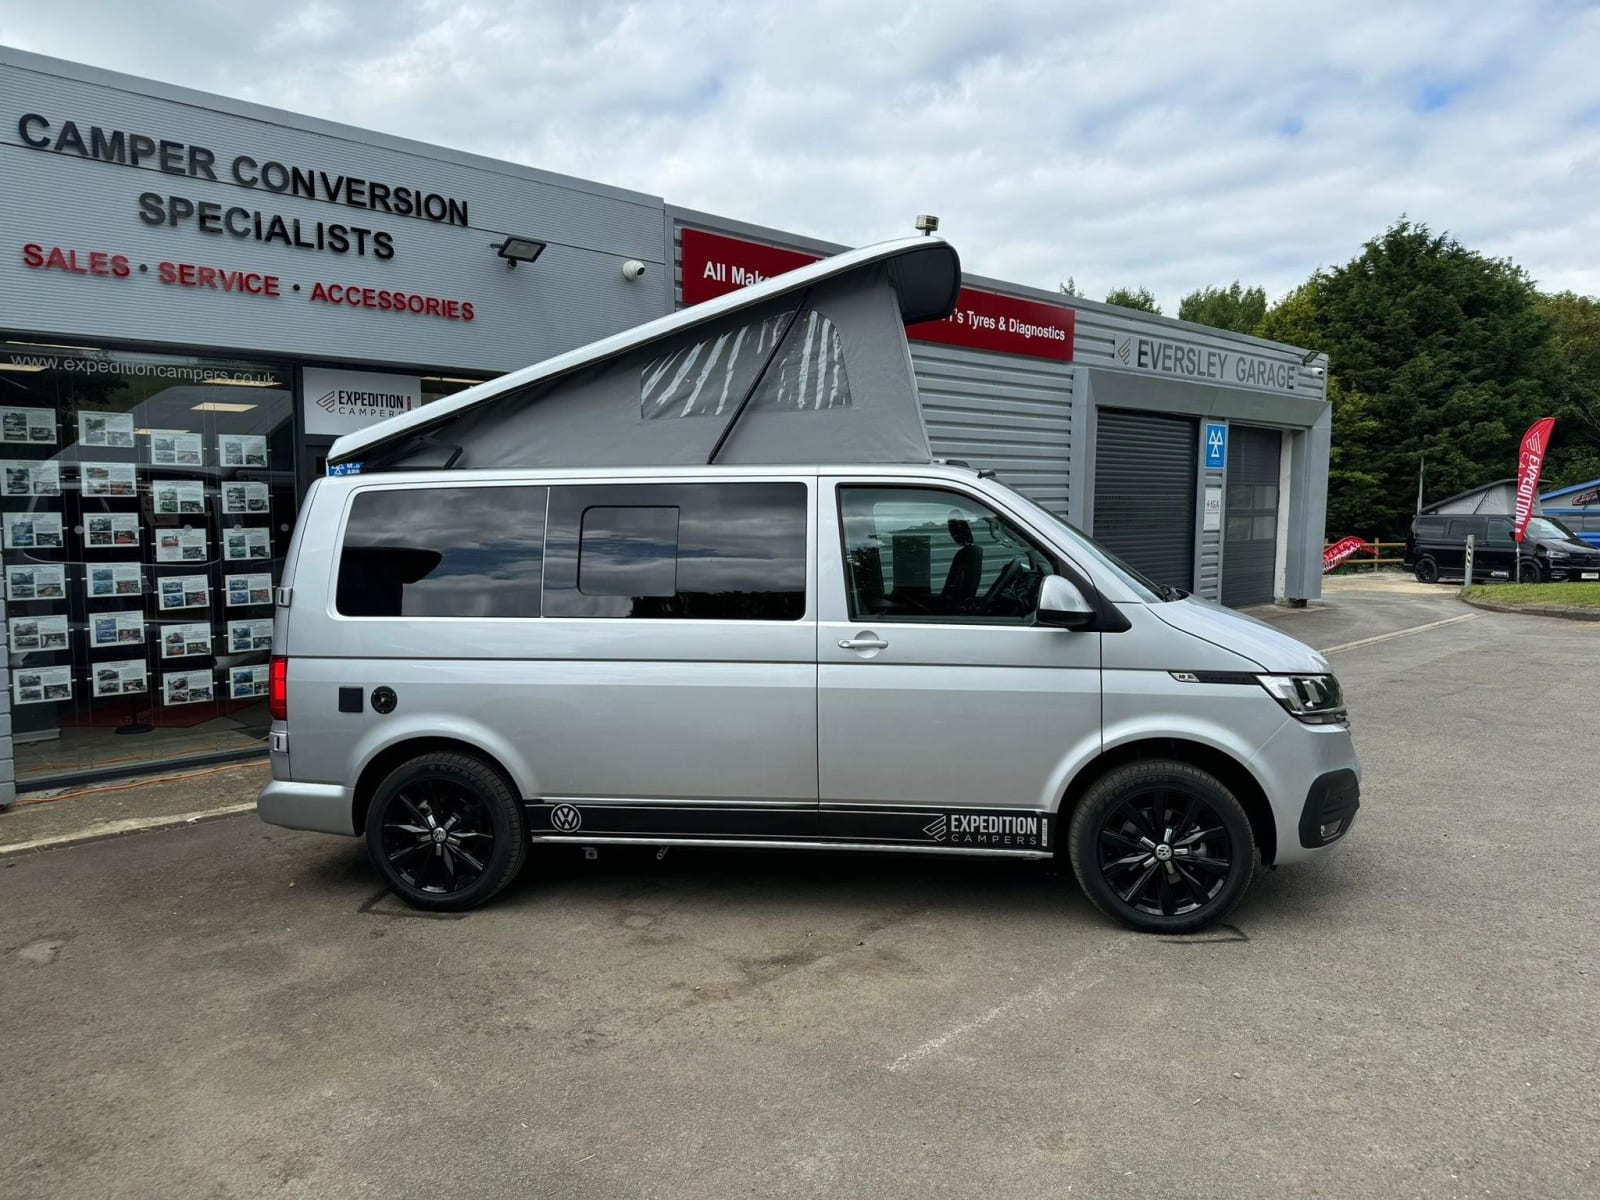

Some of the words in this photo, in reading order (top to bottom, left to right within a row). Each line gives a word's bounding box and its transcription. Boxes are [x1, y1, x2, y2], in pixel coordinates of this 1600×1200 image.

[18, 113, 217, 181] CAMPER
[232, 155, 468, 227] CONVERSION
[139, 192, 395, 260] SPECIALISTS
[23, 243, 130, 278] SALES
[159, 261, 280, 296] SERVICE
[310, 282, 475, 321] ACCESSORIES
[703, 260, 726, 282] All
[731, 265, 771, 288] Mak
[966, 310, 996, 330] Tyres
[998, 316, 1006, 331] &
[1009, 319, 1066, 341] Diagnostics
[10, 354, 277, 386] www.expeditioncampers.co.uk
[1137, 339, 1229, 379] EVERSLEY
[1235, 357, 1296, 390] GARAGE
[339, 390, 403, 409] EXPEDITION
[1515, 454, 1540, 525] EXPEDITION
[951, 815, 1037, 834] EXPEDITION
[951, 834, 1037, 845] CAMPERS
